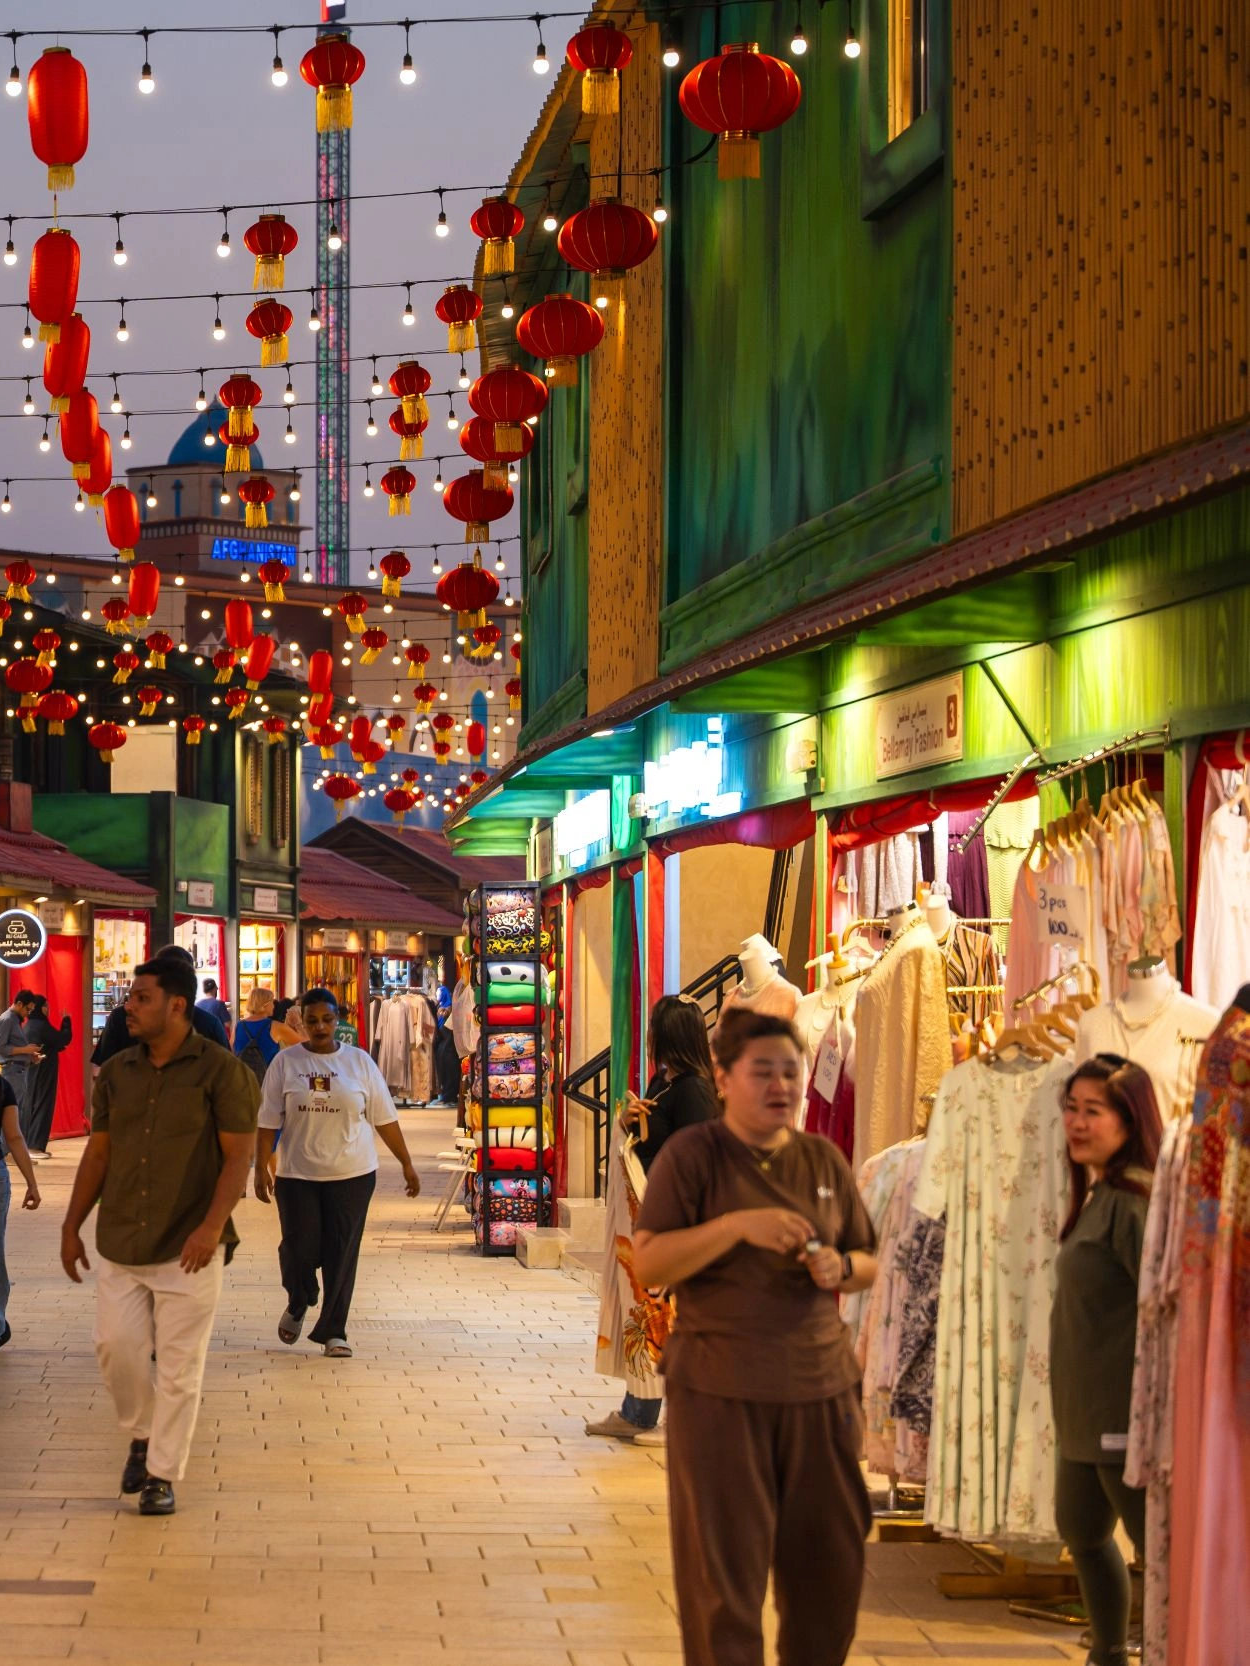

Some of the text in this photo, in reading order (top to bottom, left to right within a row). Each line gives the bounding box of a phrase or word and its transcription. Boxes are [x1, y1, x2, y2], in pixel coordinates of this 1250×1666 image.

[212, 537, 296, 567] AFGHANISTAN
[883, 724, 943, 763] Bellamay Fashion
[1039, 888, 1047, 910] 3
